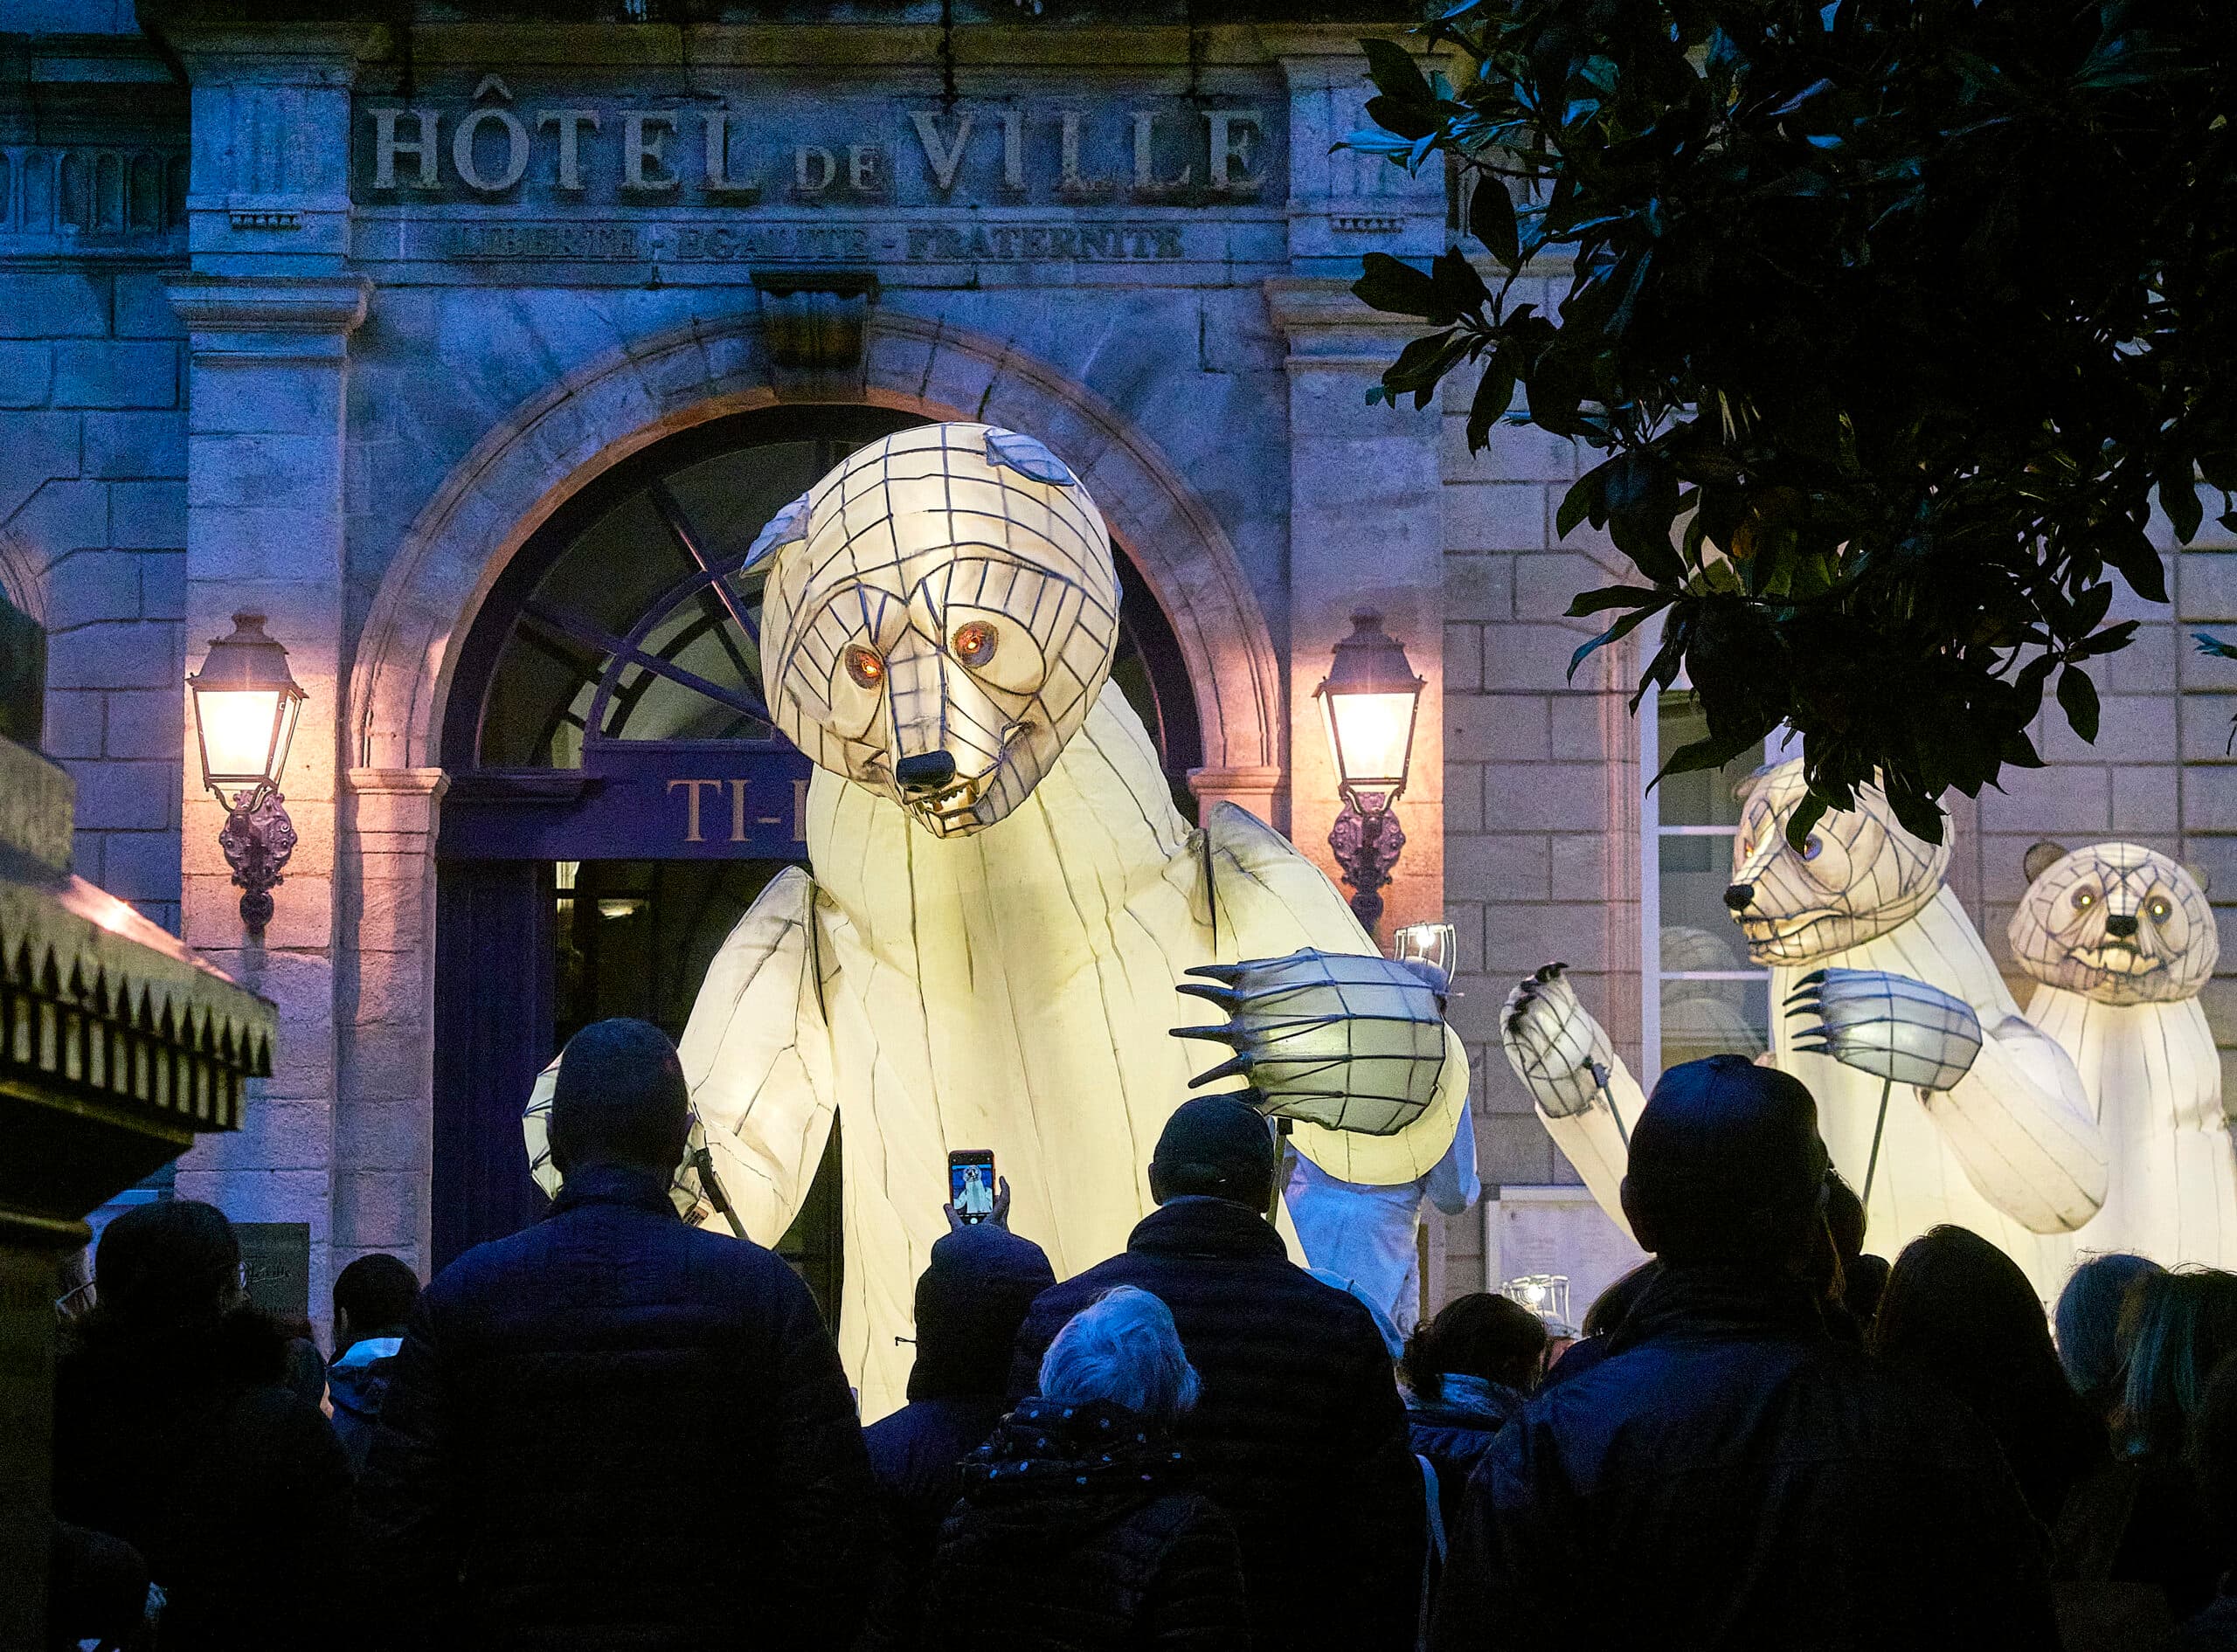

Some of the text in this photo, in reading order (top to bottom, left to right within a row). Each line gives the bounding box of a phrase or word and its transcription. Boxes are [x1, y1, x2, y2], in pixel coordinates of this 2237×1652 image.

[367, 74, 1269, 191] HÔTEL DE VILLE
